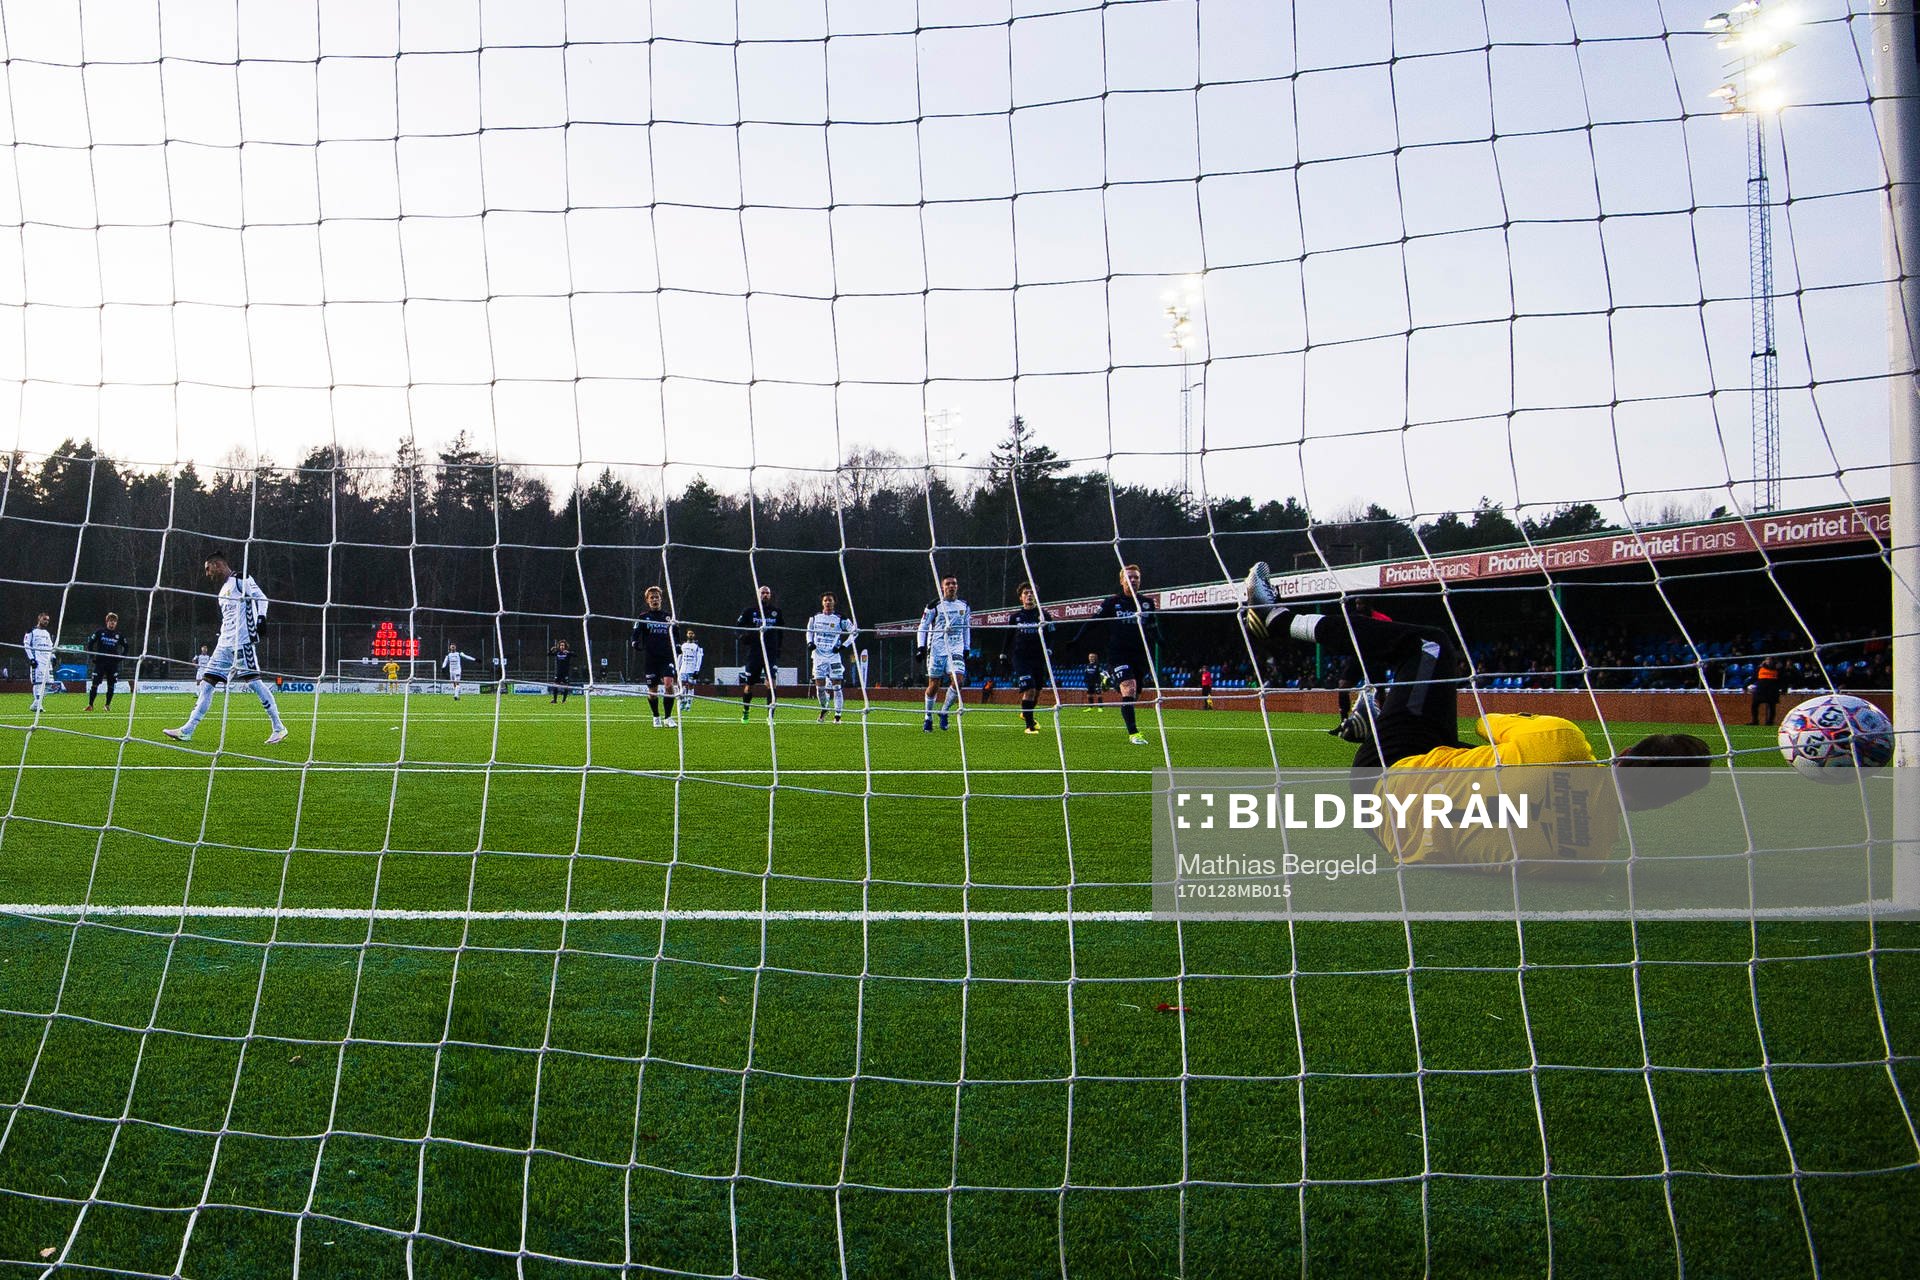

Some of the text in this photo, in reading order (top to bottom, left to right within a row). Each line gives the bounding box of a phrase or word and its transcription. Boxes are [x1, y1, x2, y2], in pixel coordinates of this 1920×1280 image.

[1763, 511, 1892, 543] Prioritet Fina
[1611, 530, 1736, 559] Prioritet Finans
[1488, 547, 1590, 572] Prioritet Finans
[1385, 565, 1434, 583] Prioritet
[1301, 576, 1338, 593] Finans
[1169, 587, 1239, 607] Prioritet Finan
[1064, 605, 1088, 617] Prioritet
[282, 683, 315, 693] ASKO
